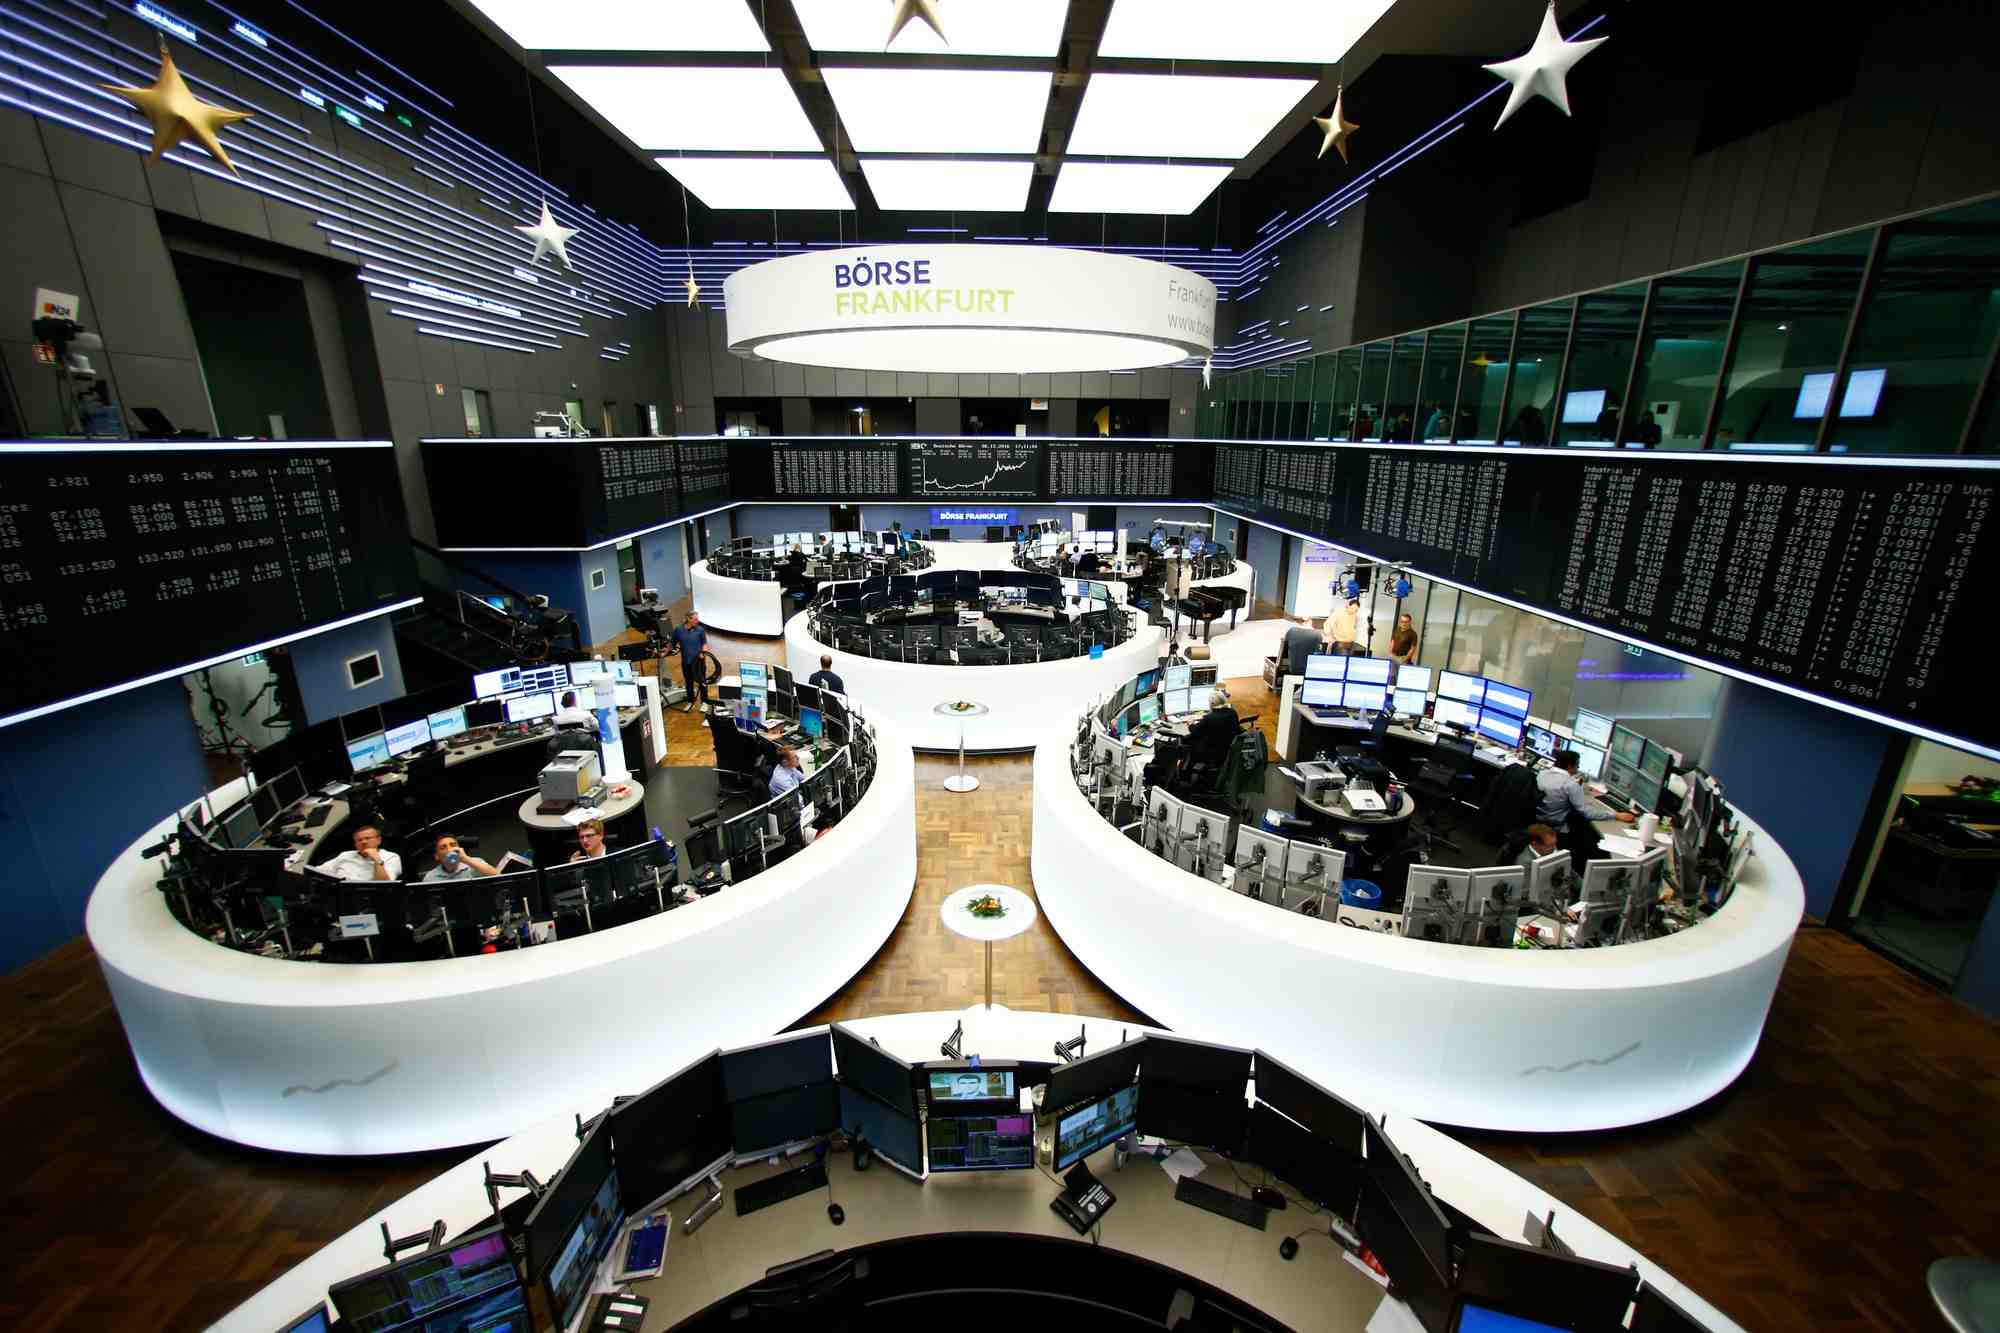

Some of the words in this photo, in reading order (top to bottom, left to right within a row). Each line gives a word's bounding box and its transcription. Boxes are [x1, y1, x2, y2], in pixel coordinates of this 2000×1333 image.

[835, 257, 931, 288] BÖRSE
[835, 288, 1015, 316] FRANKFURT
[1905, 481, 1953, 494] 17:10
[1960, 484, 1996, 496] Uhr
[1799, 486, 1845, 498] 63,870
[1892, 492, 1940, 505] 0,781
[1968, 497, 1990, 508] 16
[940, 511, 964, 520] BÖRSE
[966, 512, 1008, 520] FRANKFURT
[1793, 506, 1838, 519] 51,232
[1796, 496, 1842, 509] 36,930
[1888, 503, 1936, 516] 0,930
[1964, 509, 1986, 520] 13
[1881, 525, 1928, 539] 0,095
[1878, 536, 1925, 550] 0,091
[1875, 547, 1921, 561] 0,432
[1871, 557, 1917, 572] 0,004
[1868, 568, 1914, 583] 1,162
